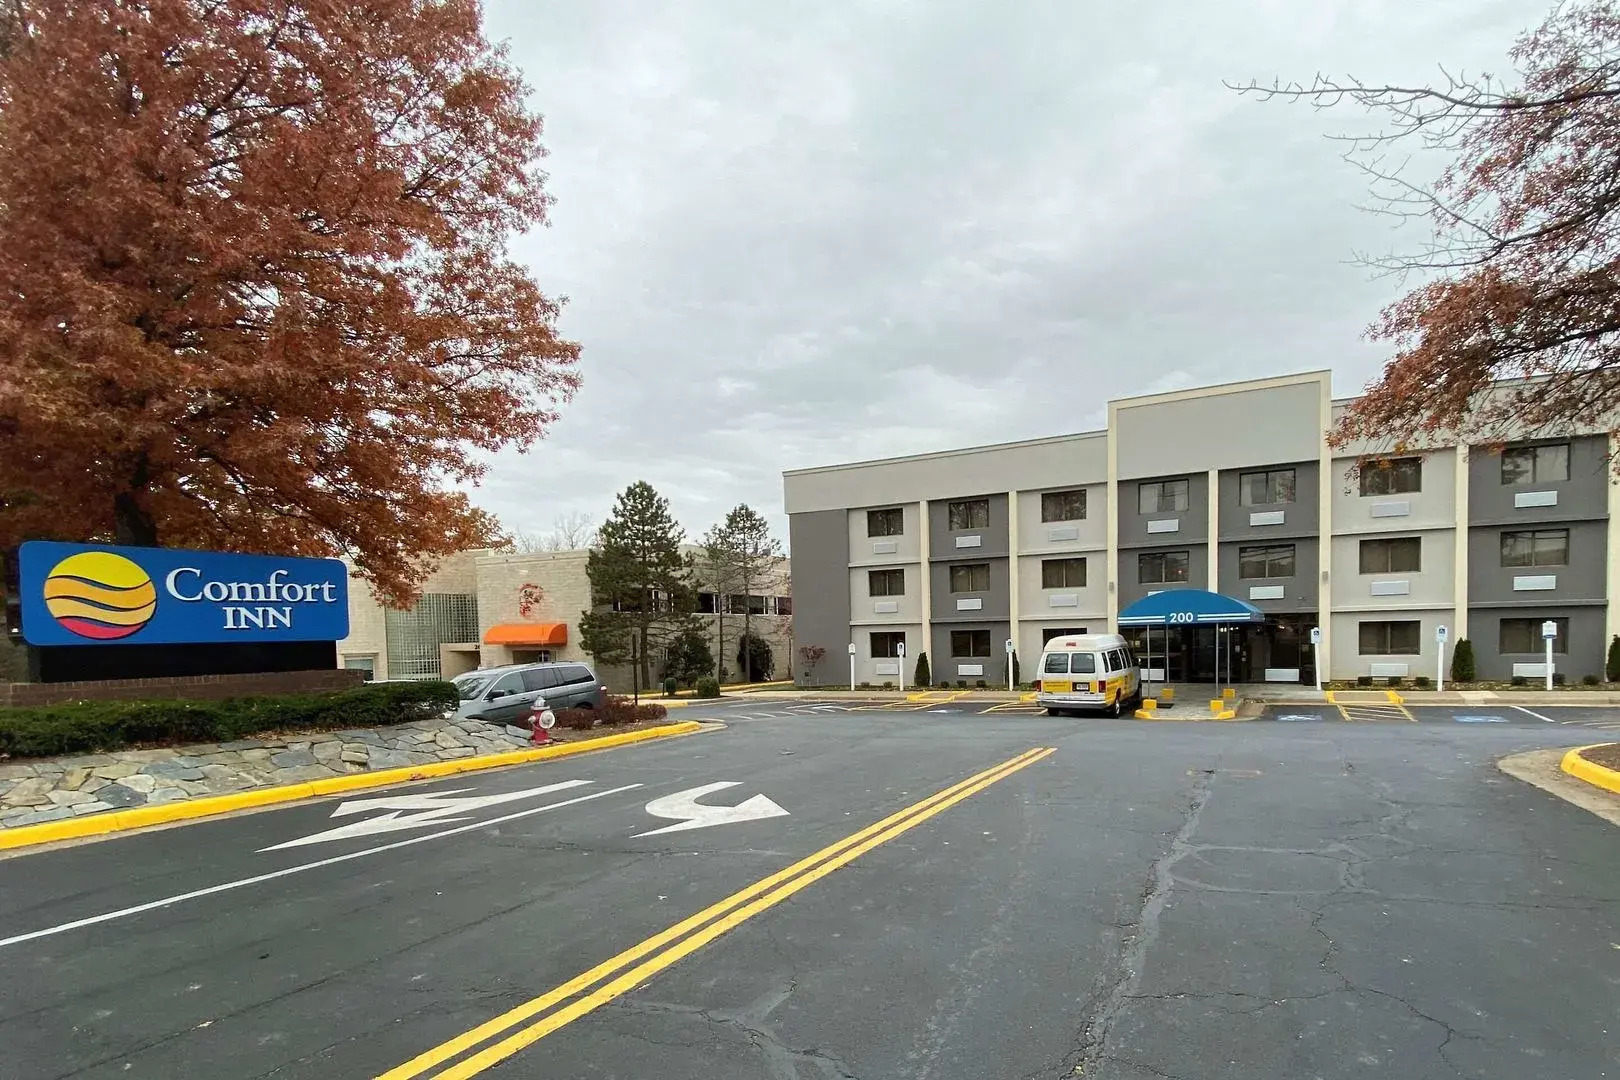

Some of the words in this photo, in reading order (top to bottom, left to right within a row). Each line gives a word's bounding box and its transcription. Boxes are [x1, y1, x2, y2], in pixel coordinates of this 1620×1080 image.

[166, 567, 336, 602] Comfort
[223, 606, 292, 629] INN
[1169, 612, 1194, 623] 200
